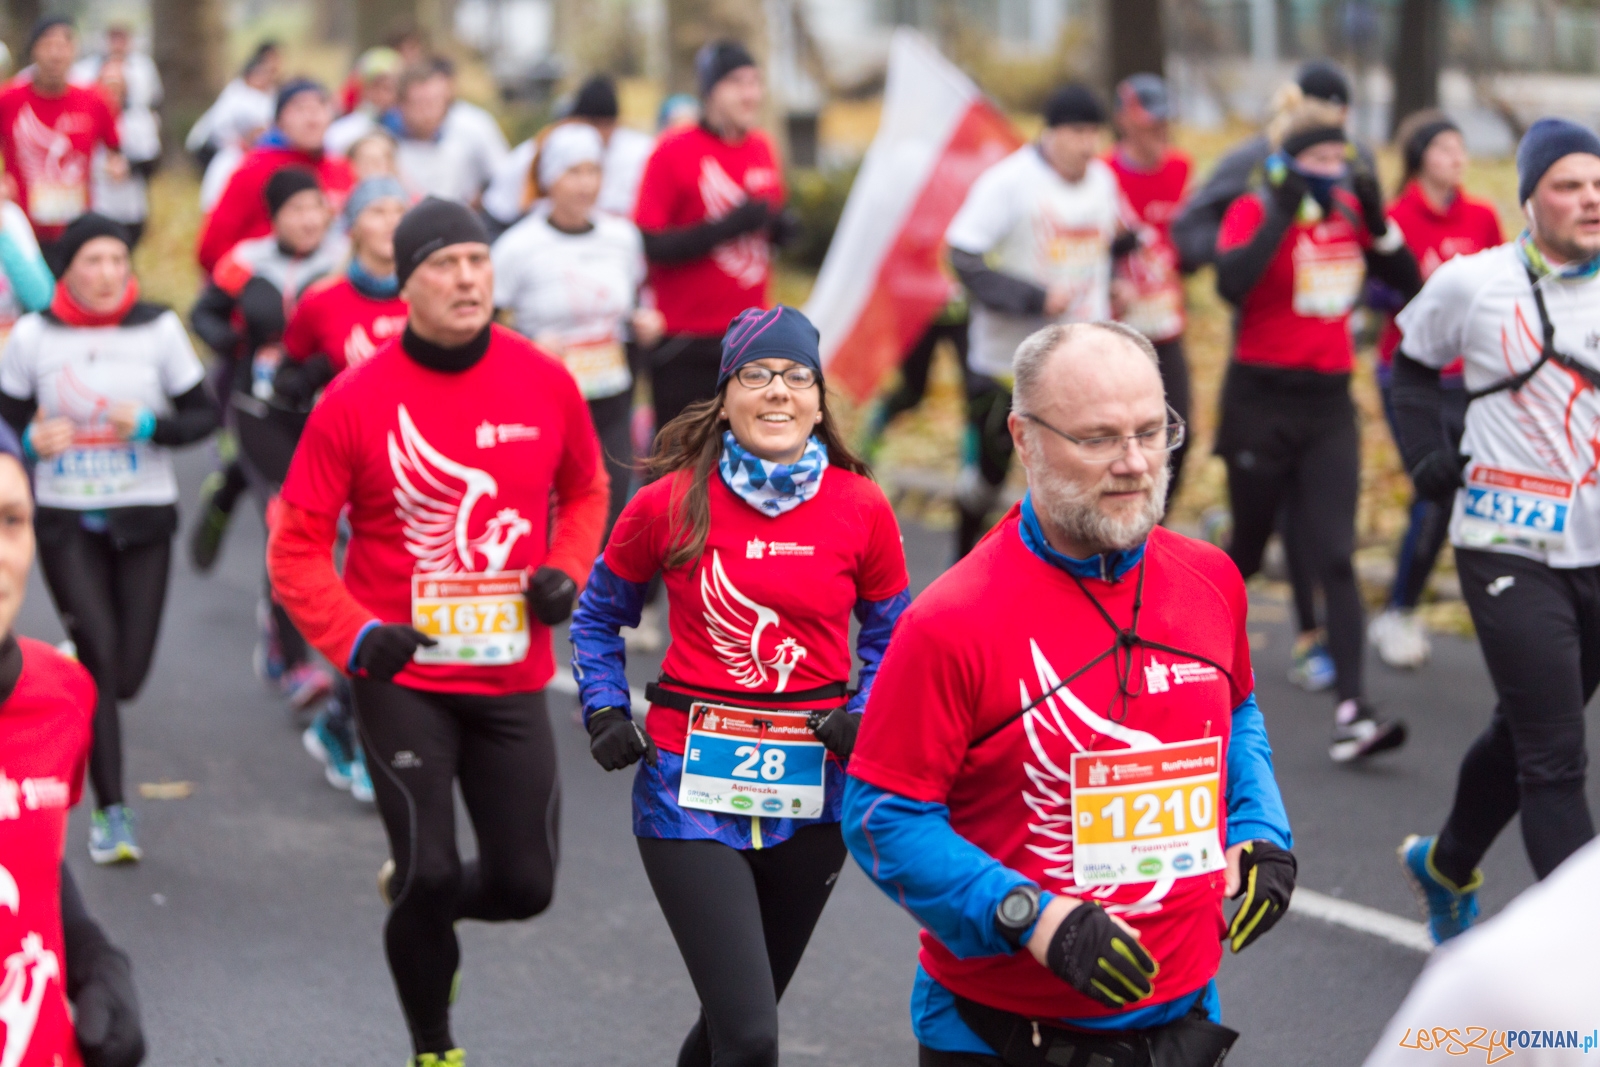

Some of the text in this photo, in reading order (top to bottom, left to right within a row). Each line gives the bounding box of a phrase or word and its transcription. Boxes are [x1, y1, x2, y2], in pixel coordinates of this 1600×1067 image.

[1475, 491, 1557, 531] 4373
[431, 602, 519, 633] 1673
[689, 745, 786, 781] E 28
[1161, 755, 1215, 772] RunPoland.org
[686, 796, 714, 805] LUXMED
[687, 789, 711, 798] GRUPA
[731, 783, 778, 795] Agnieszka
[1078, 785, 1213, 839] D 1210
